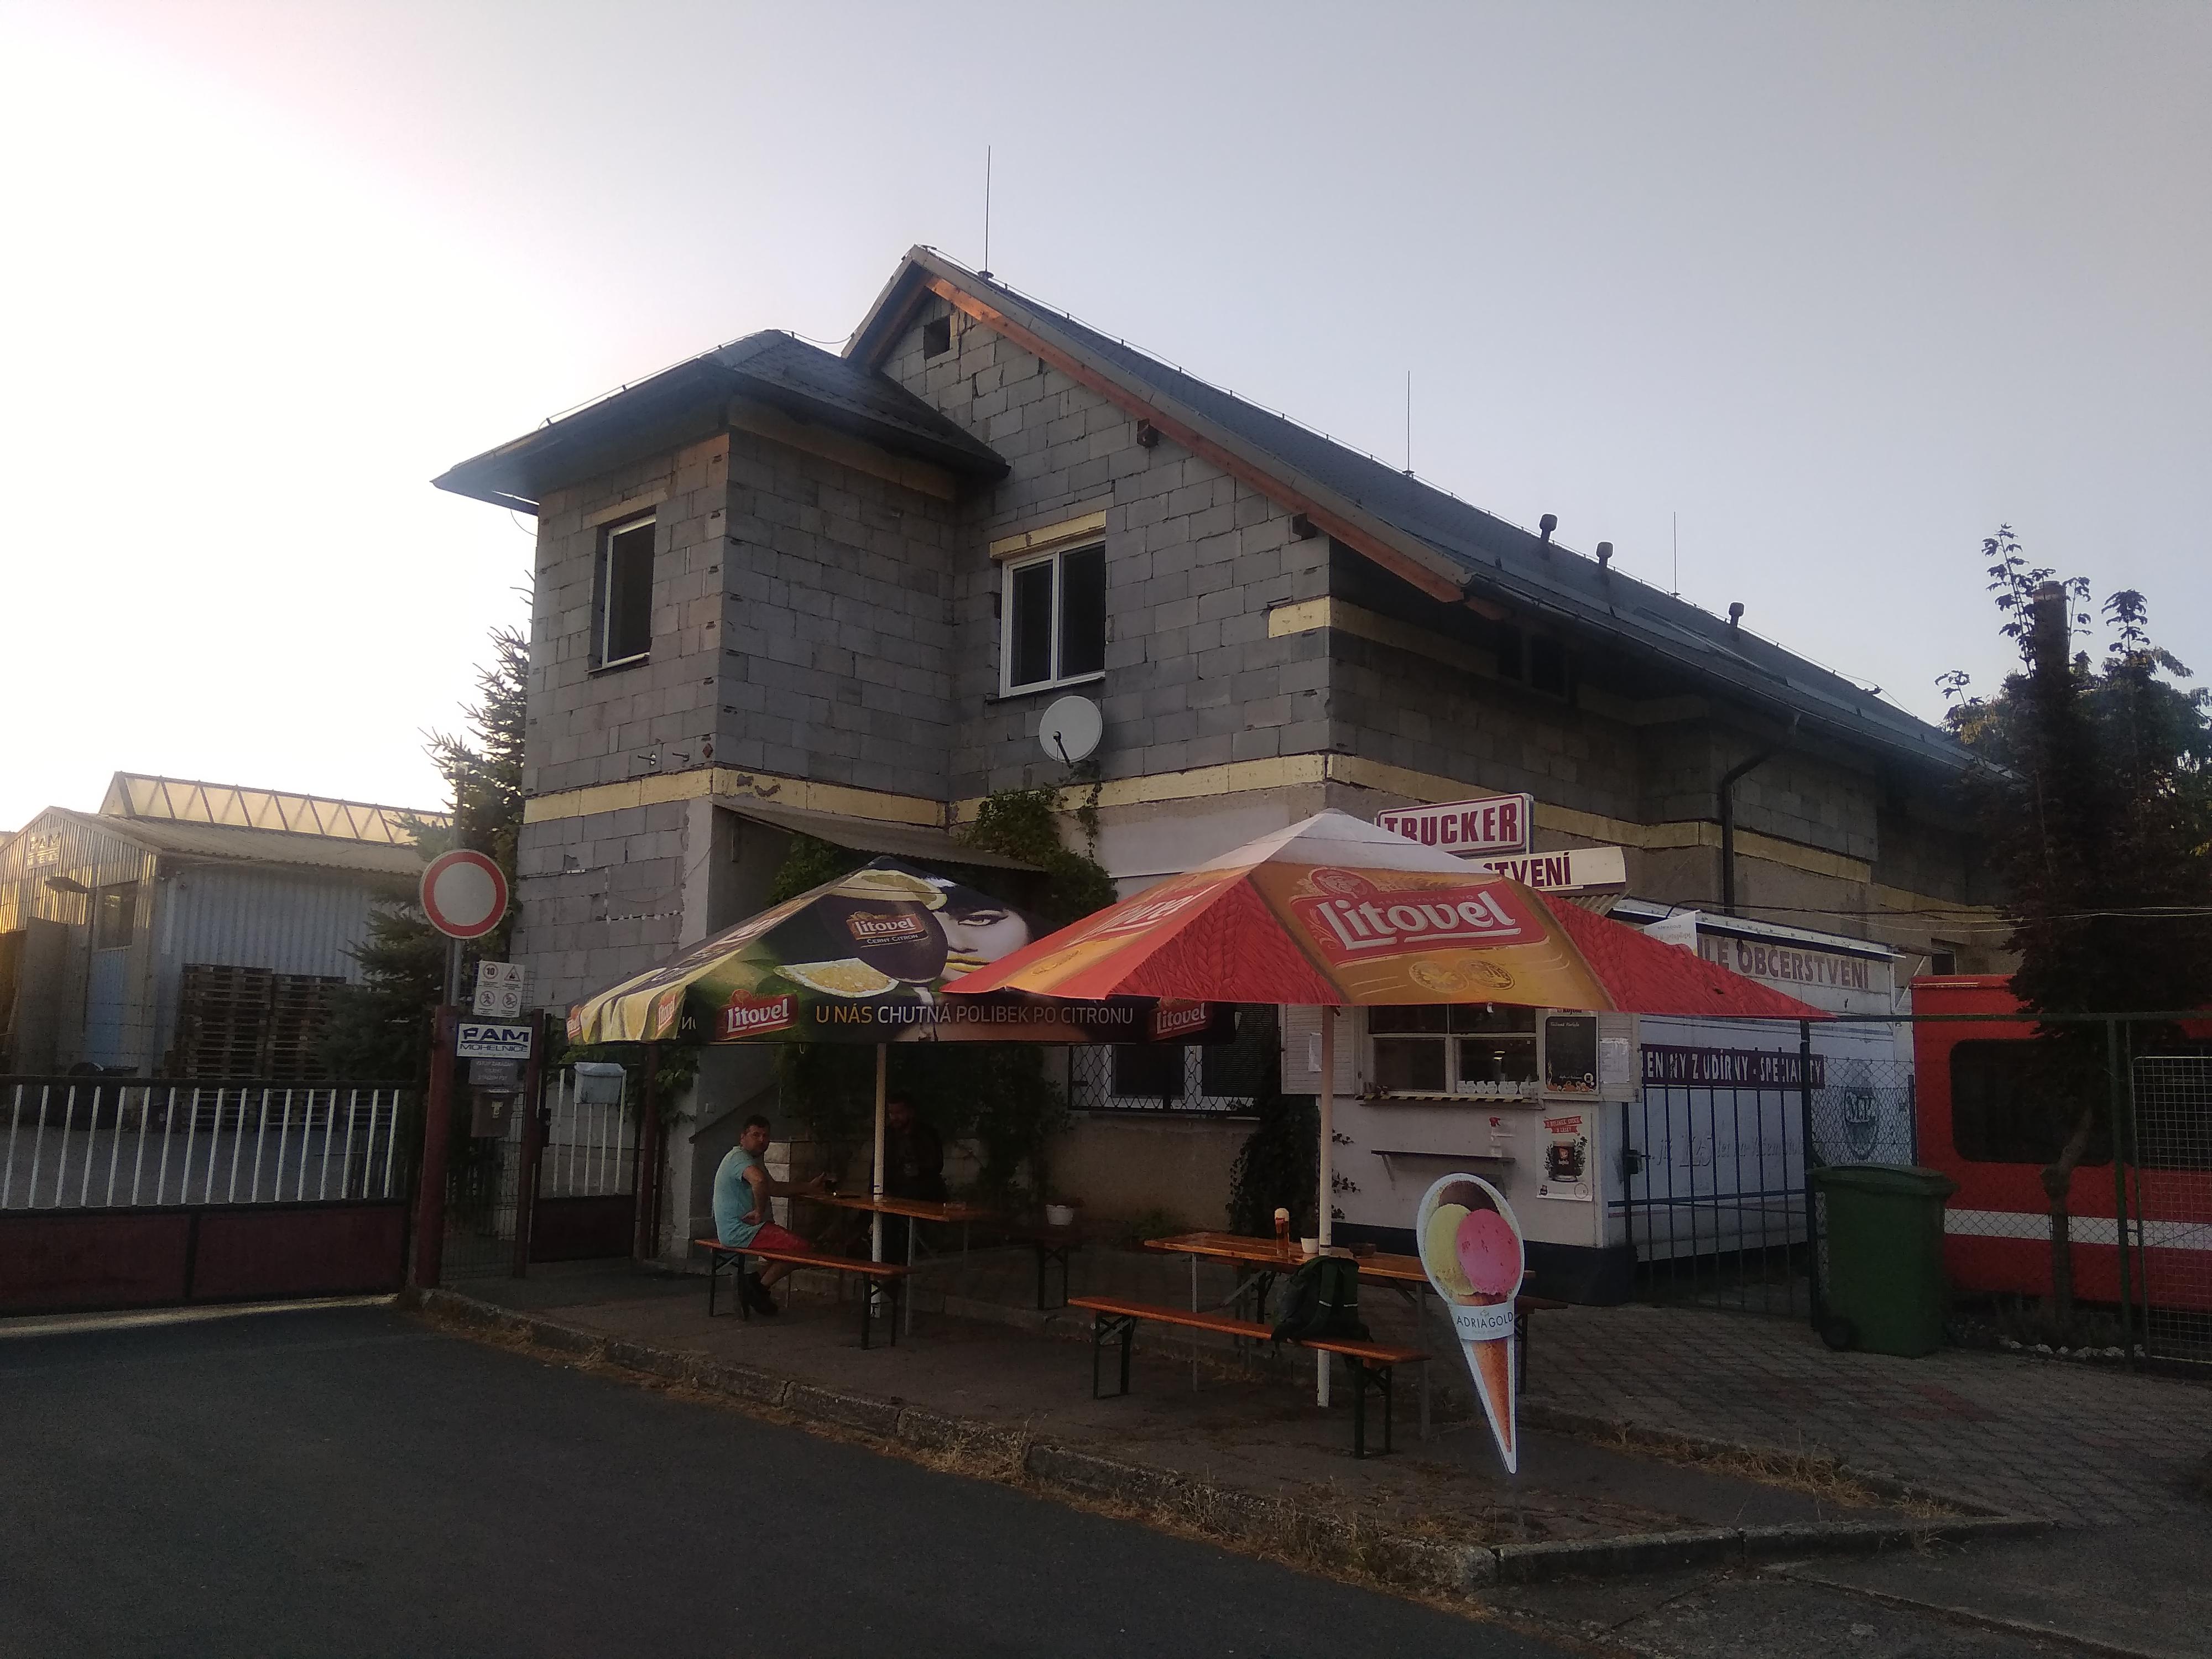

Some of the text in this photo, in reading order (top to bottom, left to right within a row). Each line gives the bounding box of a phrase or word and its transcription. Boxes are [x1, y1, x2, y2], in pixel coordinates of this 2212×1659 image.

[1384, 803, 1517, 846] TRUCKER
[1483, 852, 1571, 887] TVENÍ
[854, 917, 916, 935] Litovel
[1316, 891, 1522, 951] Litovel
[727, 998, 790, 1034] Litovel
[816, 1003, 1134, 1024] U NÁS CHUTNÁ POLIBEK PO CITRONU
[1156, 1002, 1207, 1035] Litovel
[460, 1044, 528, 1052] MOHELNICE
[463, 1027, 529, 1042] PAM
[1641, 1051, 1687, 1079] ENNY
[1692, 1053, 1699, 1079] Z
[1760, 1056, 1822, 1084] SPEIALTY
